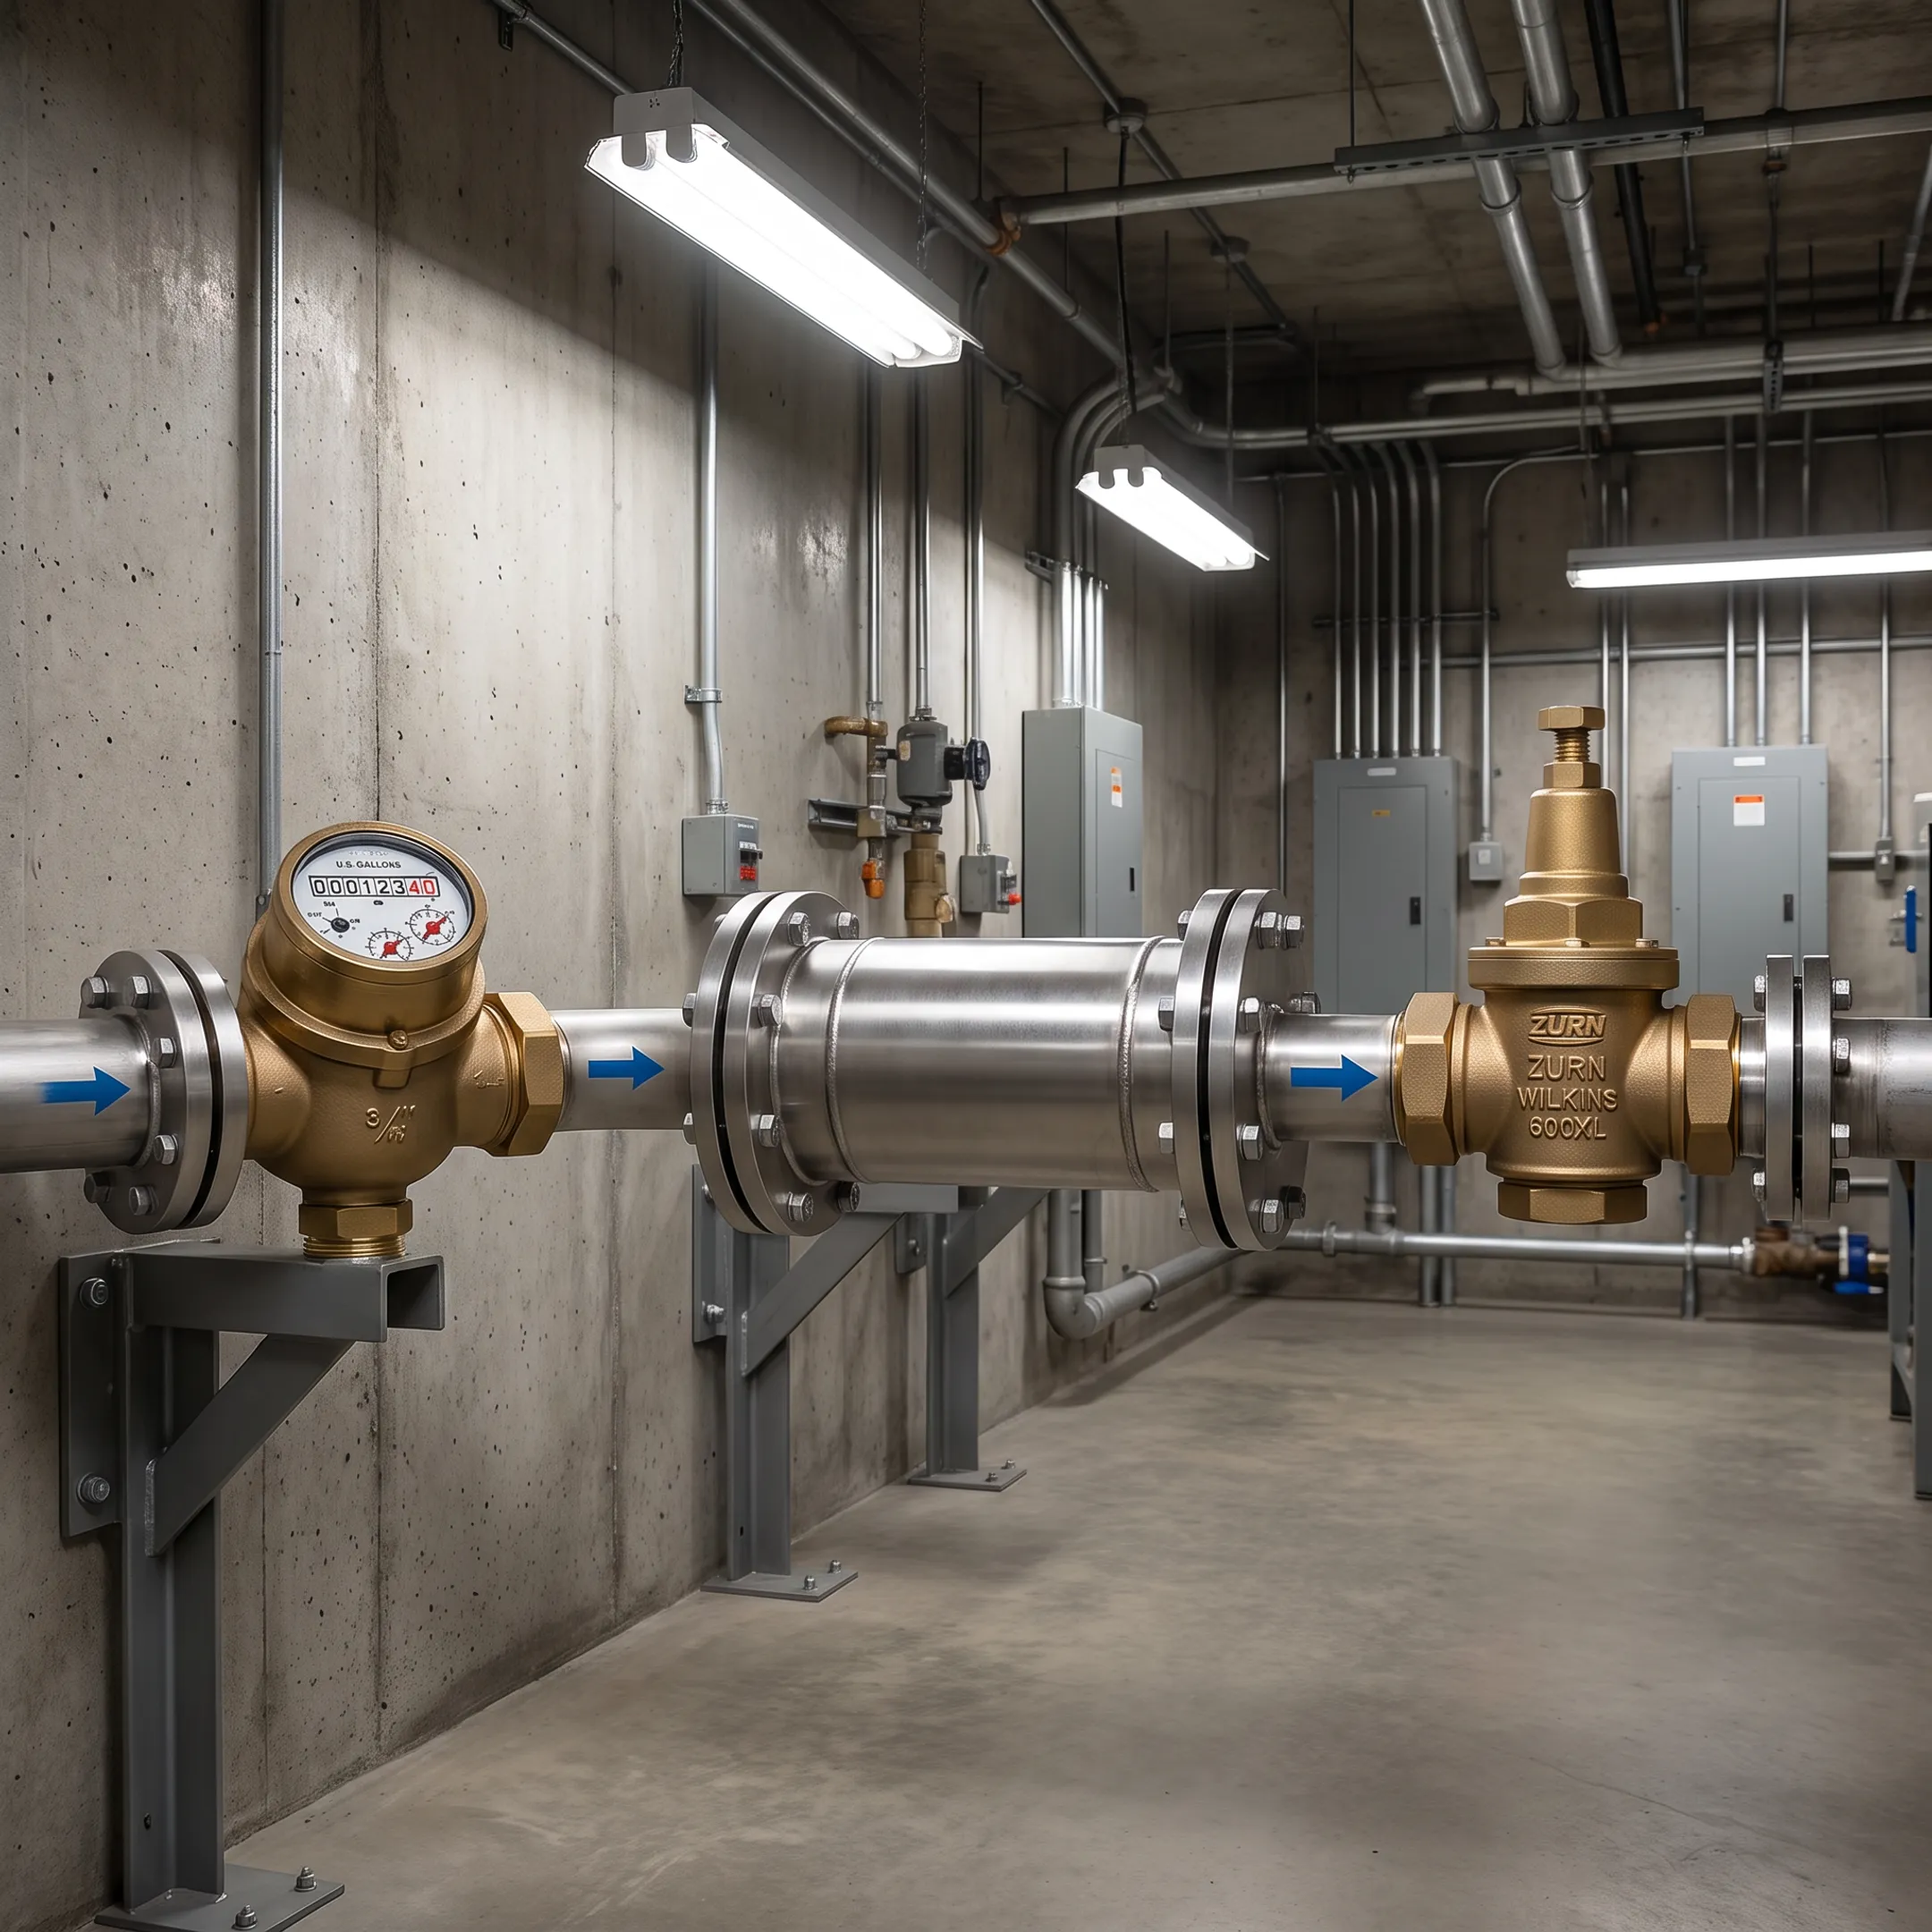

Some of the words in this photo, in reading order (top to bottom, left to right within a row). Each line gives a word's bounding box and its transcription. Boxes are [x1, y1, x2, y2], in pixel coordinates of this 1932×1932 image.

[336, 860, 355, 869] U.S.
[356, 860, 402, 869] GALLONS
[314, 879, 436, 894] 00012340
[1529, 1014, 1606, 1038] ZURN
[1528, 1054, 1606, 1080] ZURN
[1517, 1087, 1618, 1112] WILKINS
[1530, 1115, 1607, 1140] 600XL
